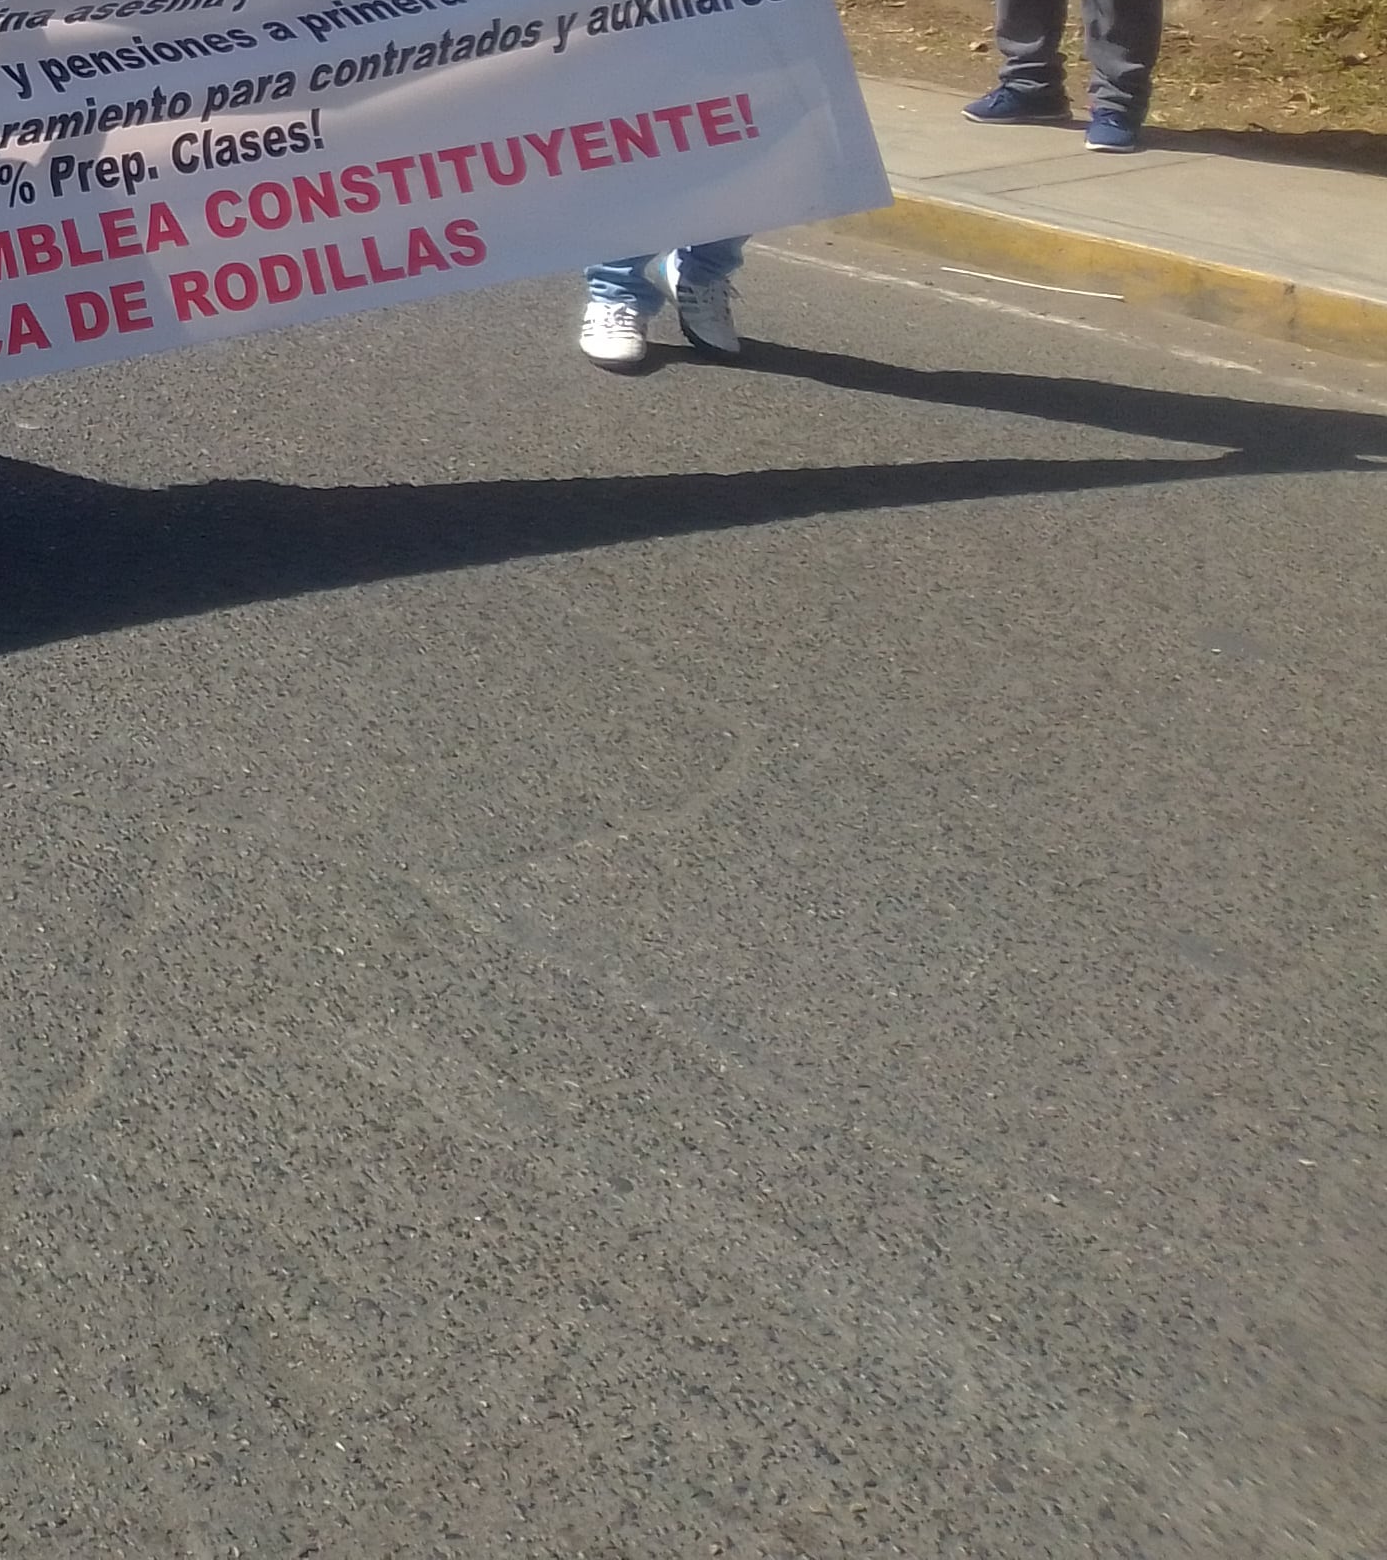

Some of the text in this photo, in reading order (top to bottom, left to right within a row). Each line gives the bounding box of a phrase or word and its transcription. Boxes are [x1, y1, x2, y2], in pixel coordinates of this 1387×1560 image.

[0, 63, 34, 101] y
[38, 17, 260, 93] pensiones
[261, 17, 298, 43] a
[199, 66, 297, 122] para
[308, 13, 545, 95] contratados
[550, 6, 578, 54] y
[48, 150, 160, 197] Prep.
[171, 107, 326, 176] Clases!
[204, 92, 761, 241] CONSTITUYENTE!
[65, 281, 154, 344] DE
[169, 218, 489, 324] RODILLAS
